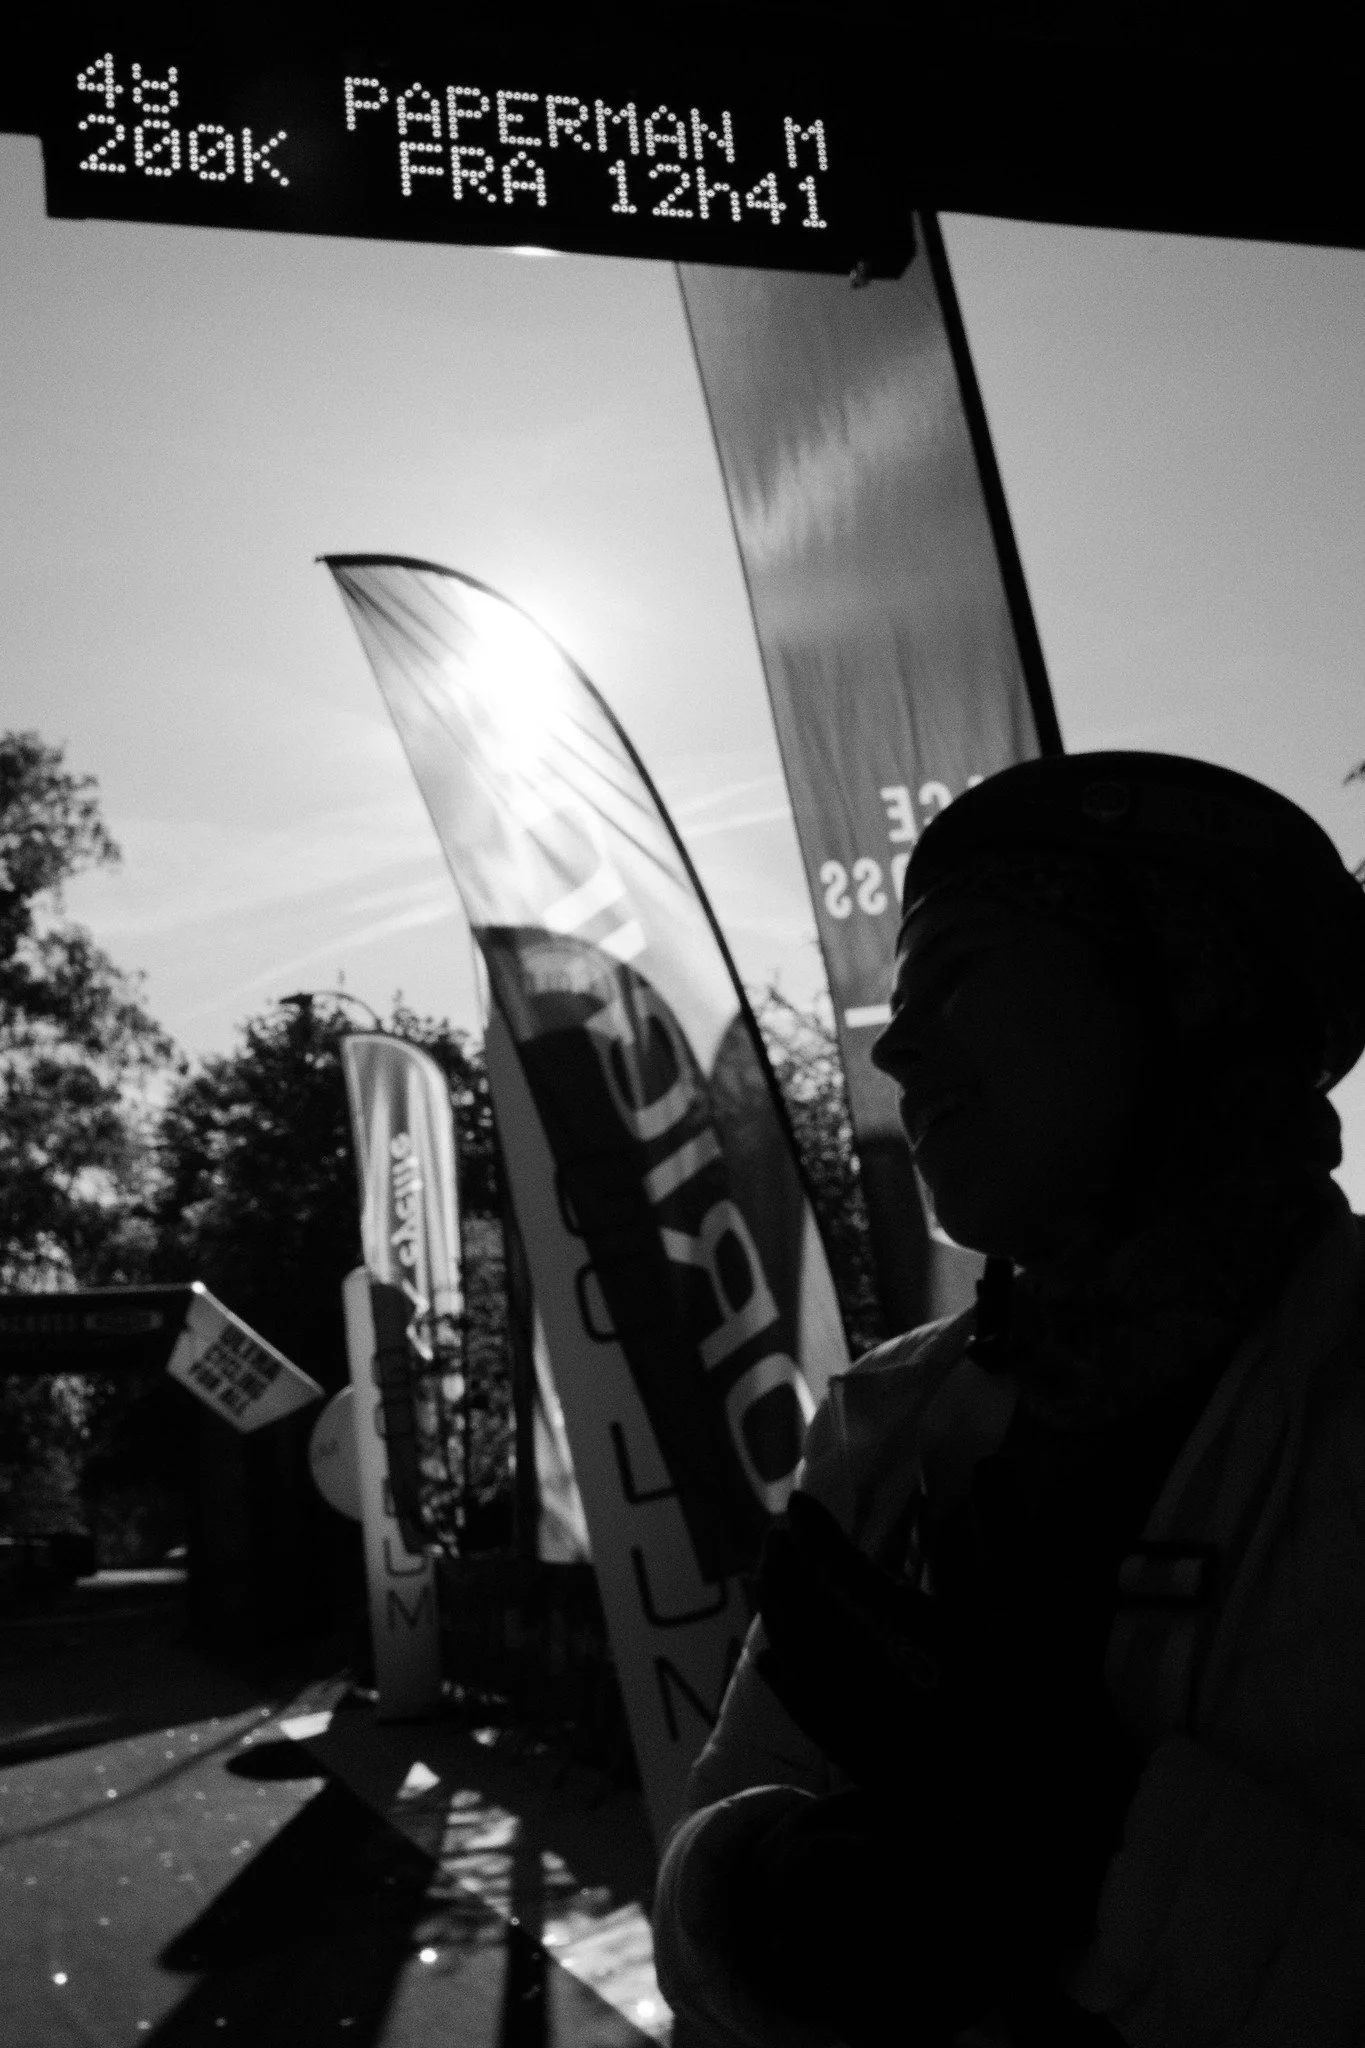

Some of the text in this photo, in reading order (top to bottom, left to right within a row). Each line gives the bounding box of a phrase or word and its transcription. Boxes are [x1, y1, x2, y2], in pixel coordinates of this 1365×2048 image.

[78, 112, 828, 229] 200K FRA 12h41
[344, 76, 736, 164] PAPERMAN
[783, 116, 829, 171] M
